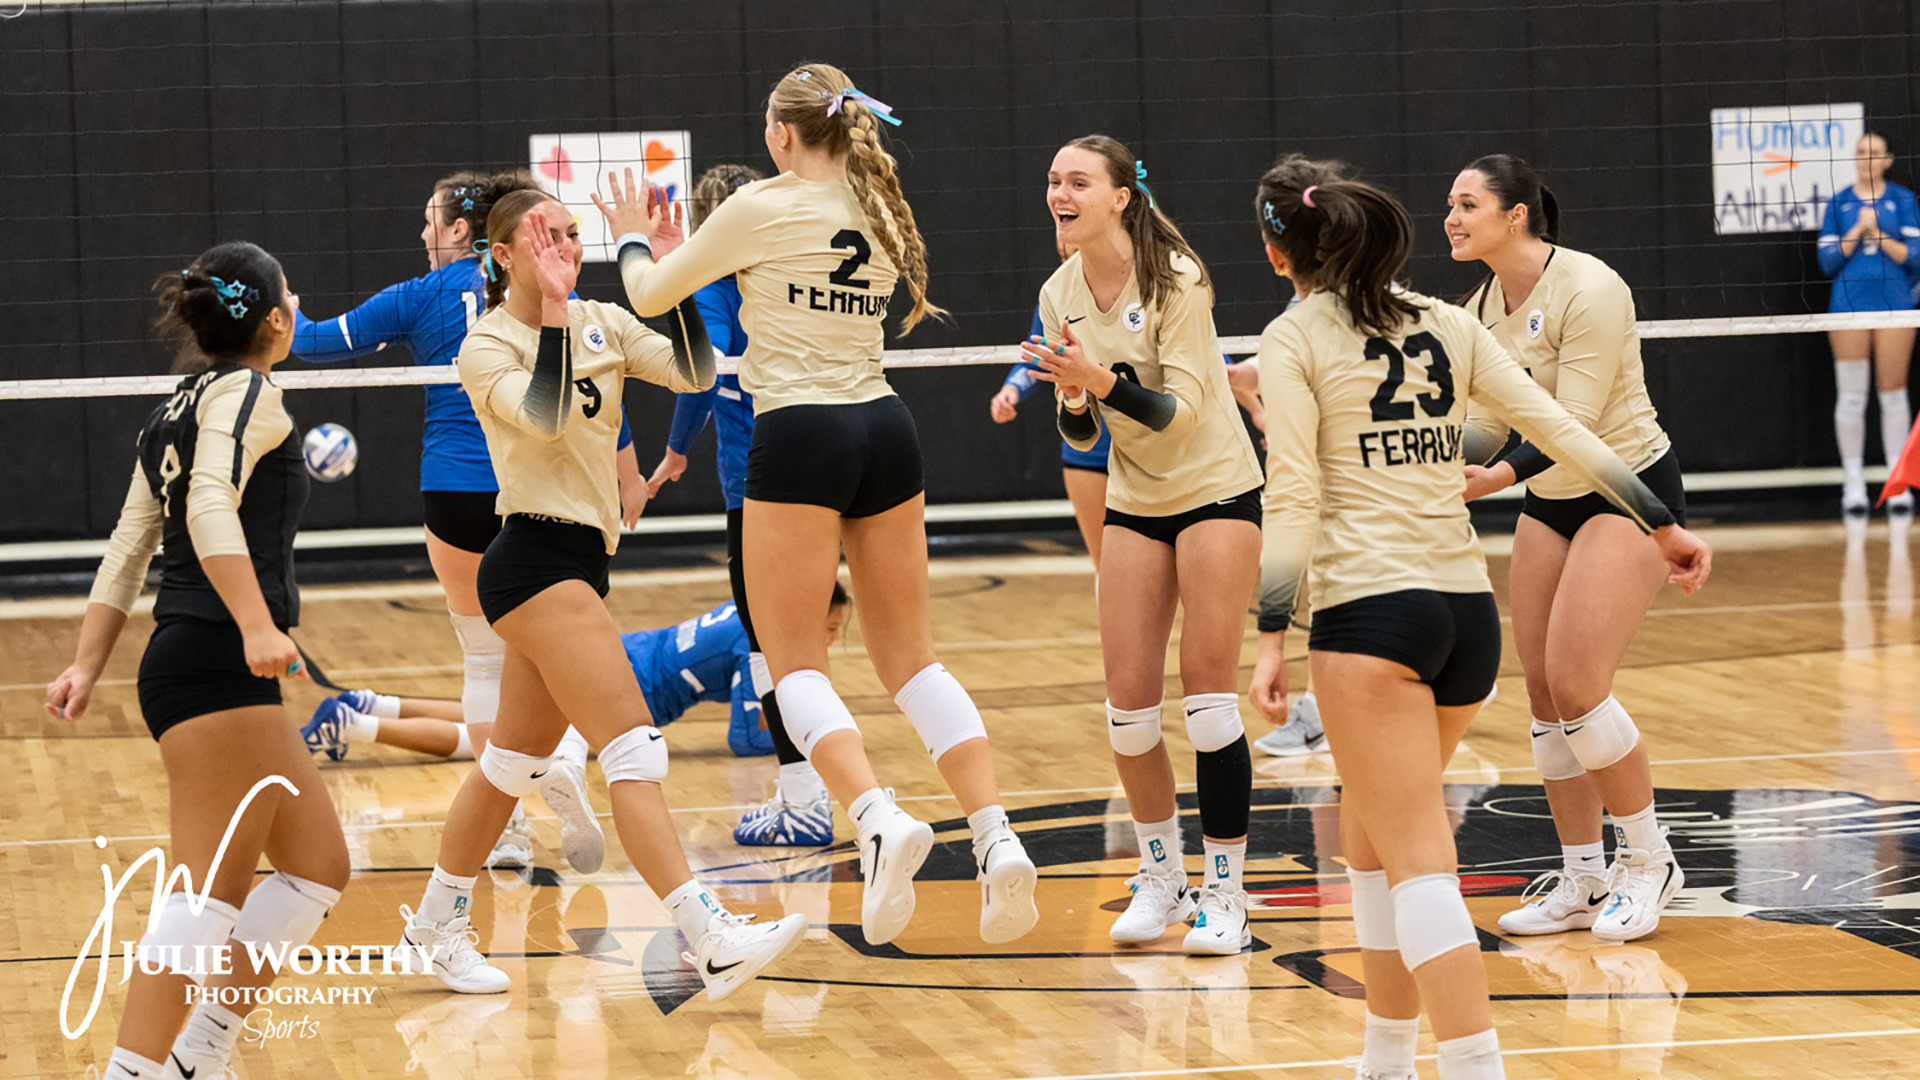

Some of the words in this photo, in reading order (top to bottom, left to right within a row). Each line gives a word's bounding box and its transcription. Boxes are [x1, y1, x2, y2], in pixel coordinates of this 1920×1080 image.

[1715, 111, 1845, 151] Human
[1718, 183, 1833, 231] Athlet
[829, 229, 871, 289] 2
[1363, 330, 1455, 422] 23
